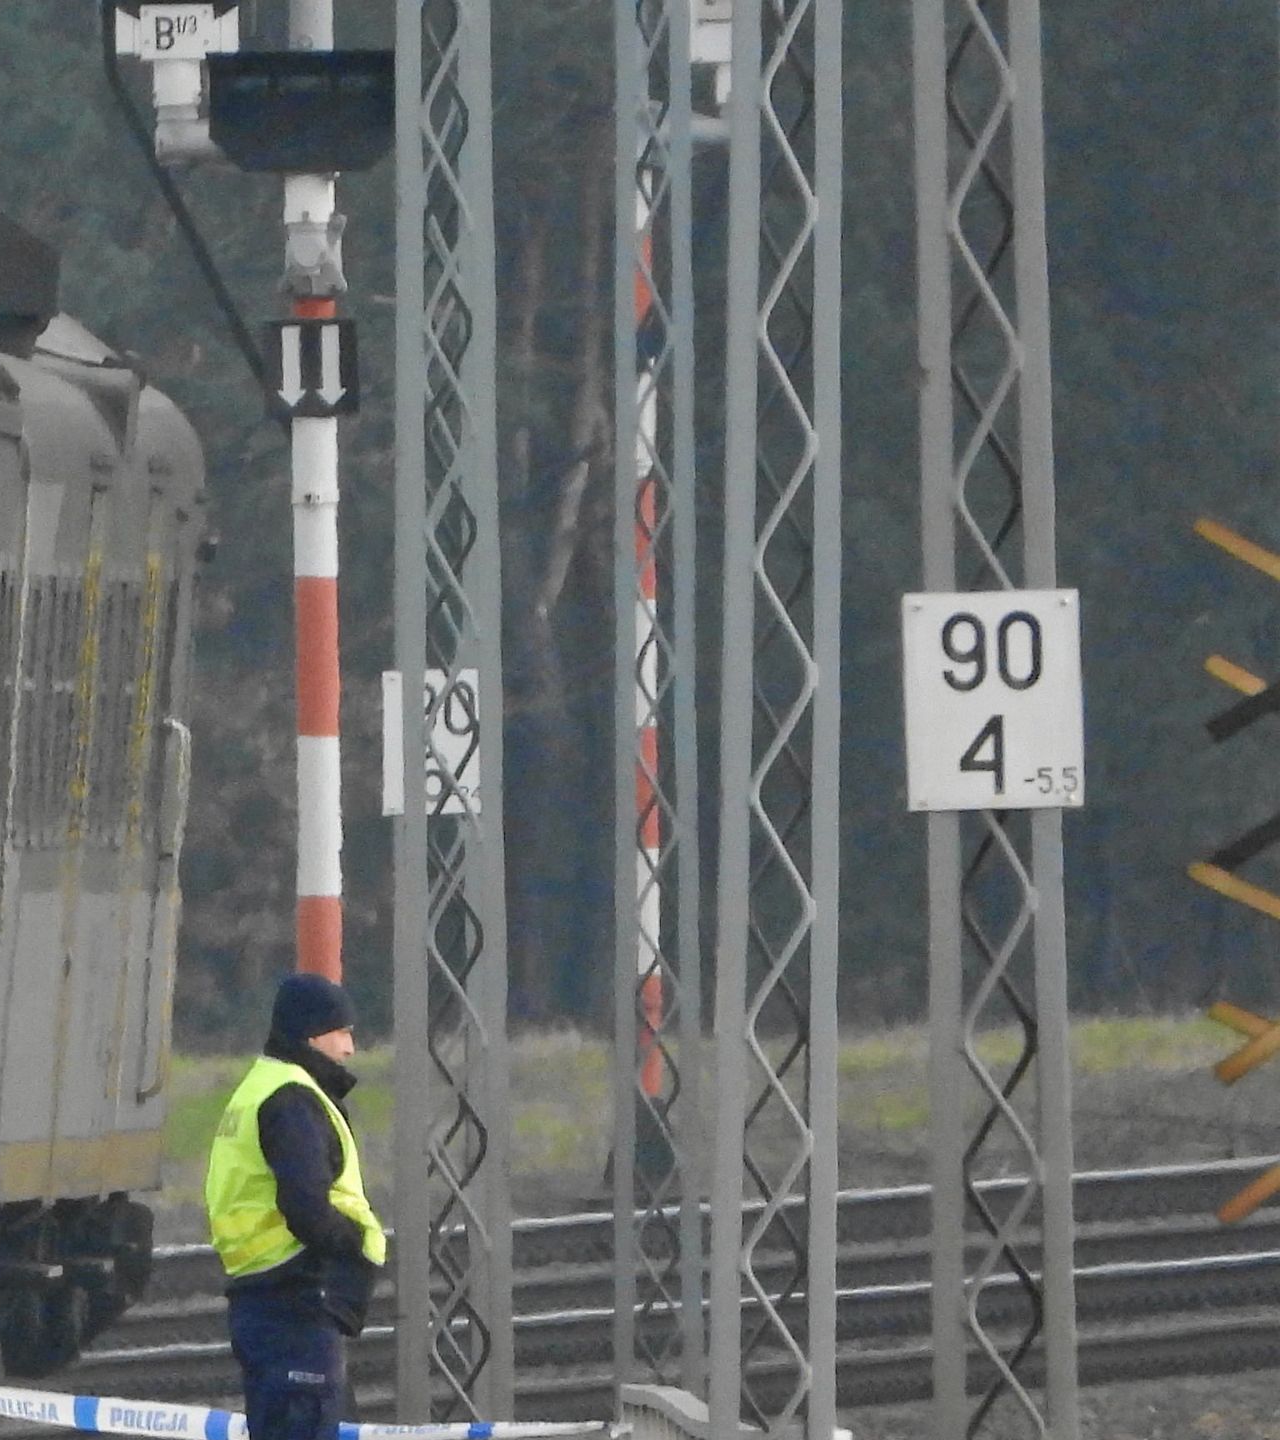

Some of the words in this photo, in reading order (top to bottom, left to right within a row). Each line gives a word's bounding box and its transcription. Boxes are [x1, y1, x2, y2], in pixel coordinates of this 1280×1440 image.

[941, 610, 1043, 691] 90
[959, 714, 1005, 795] 4
[109, 1407, 189, 1432] POLICJA
